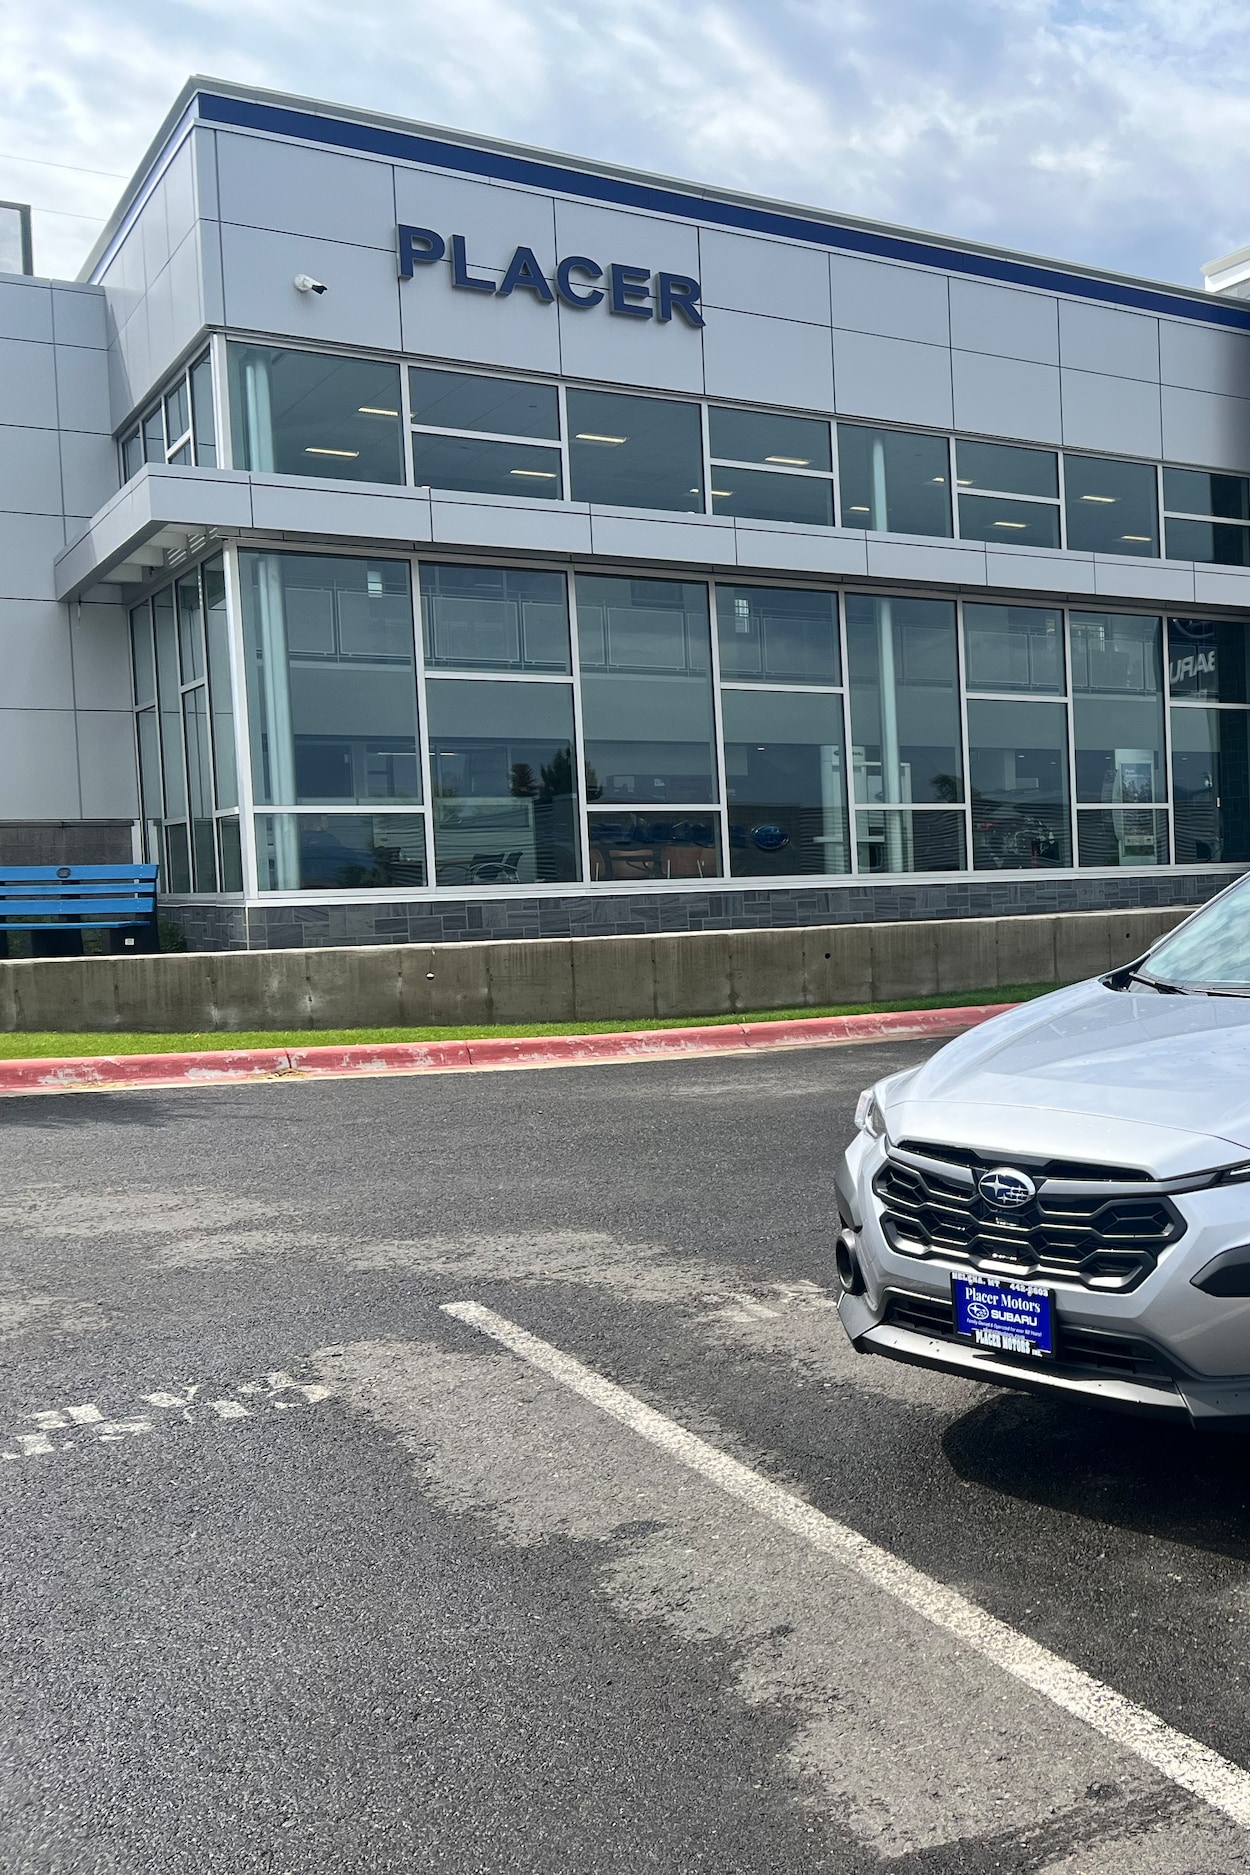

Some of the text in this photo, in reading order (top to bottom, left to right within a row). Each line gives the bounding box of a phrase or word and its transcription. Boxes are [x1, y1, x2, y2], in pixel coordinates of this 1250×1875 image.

[396, 223, 707, 328] PLACER
[965, 1287, 1041, 1313] Placer Motors
[990, 1309, 1038, 1327] SUBARU
[975, 1330, 1002, 1348] PLACER
[1002, 1335, 1031, 1355] MOTORS
